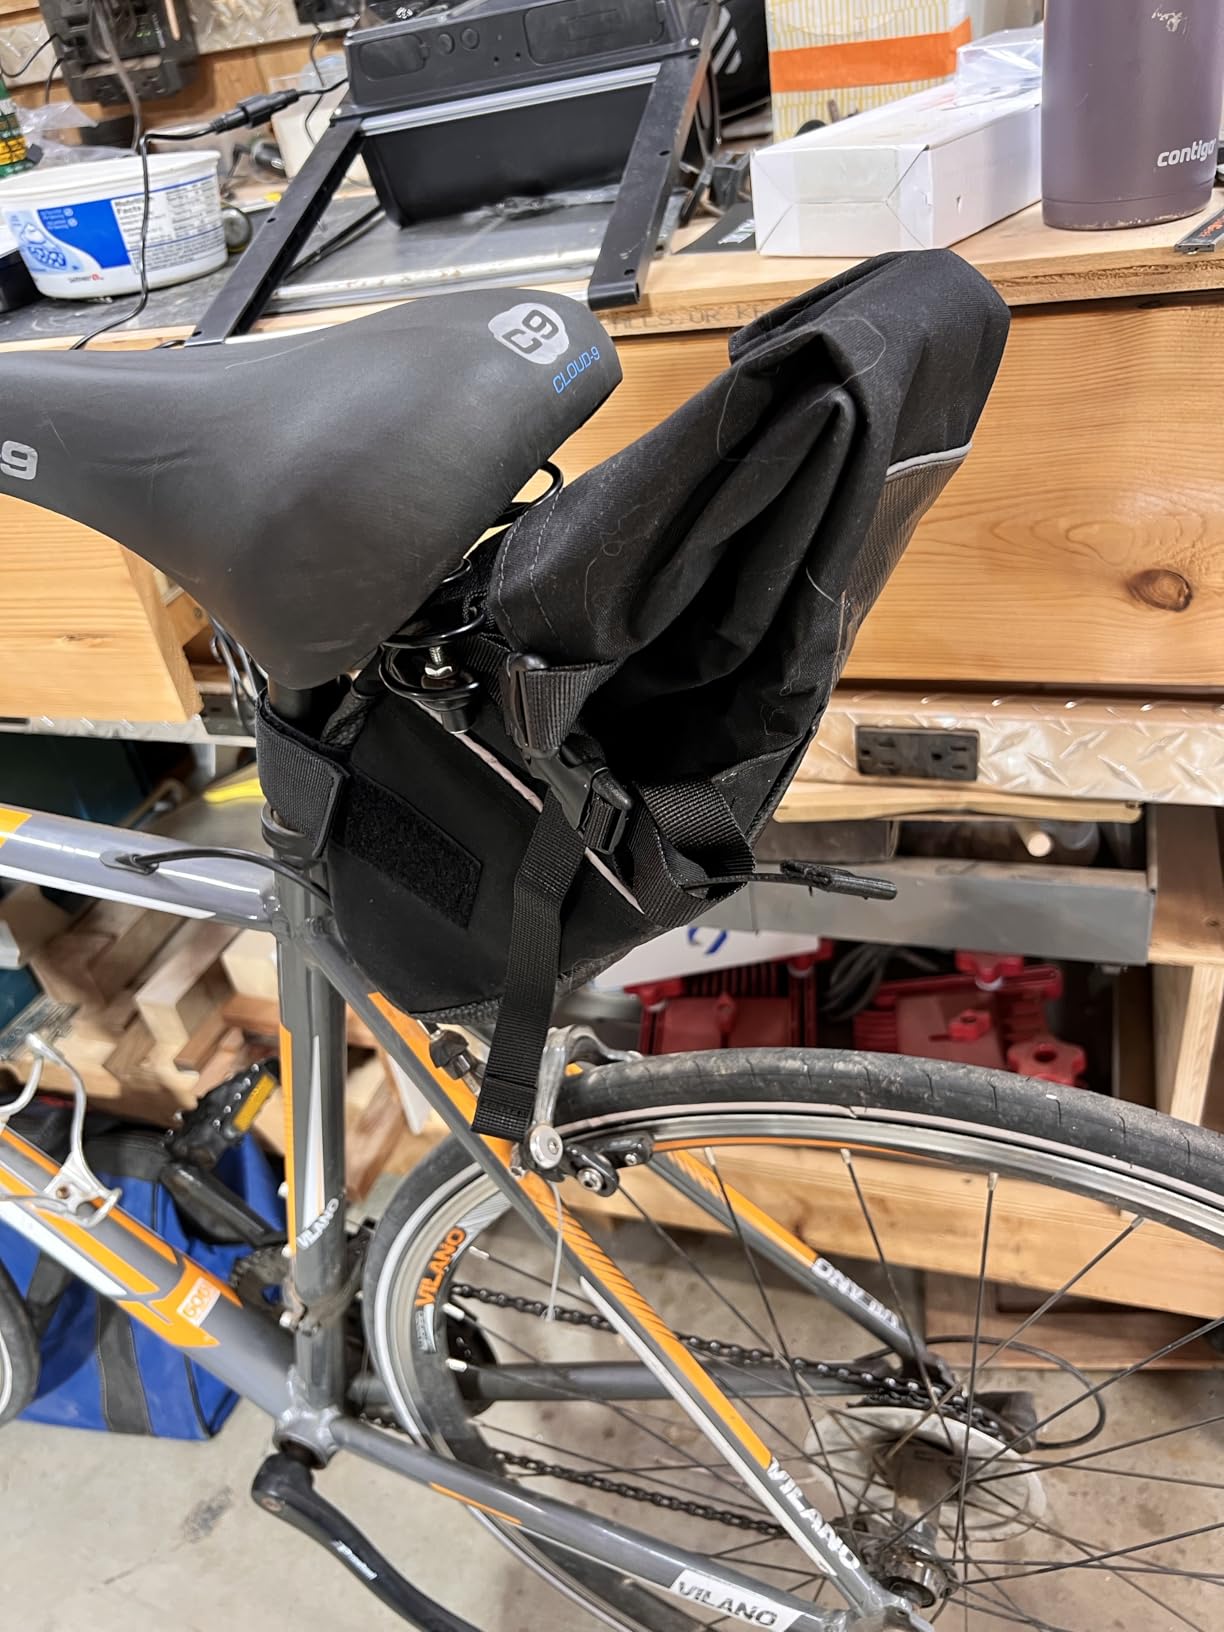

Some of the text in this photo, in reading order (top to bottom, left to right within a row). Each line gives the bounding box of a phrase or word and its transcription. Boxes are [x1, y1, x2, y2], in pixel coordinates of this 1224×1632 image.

[1156, 138, 1217, 167] contigo
[500, 308, 560, 355] C9
[552, 346, 601, 394] CLOUD-9
[414, 1226, 467, 1307] VILANO
[766, 1456, 862, 1571] VILANO
[678, 1580, 779, 1628] VILANO
